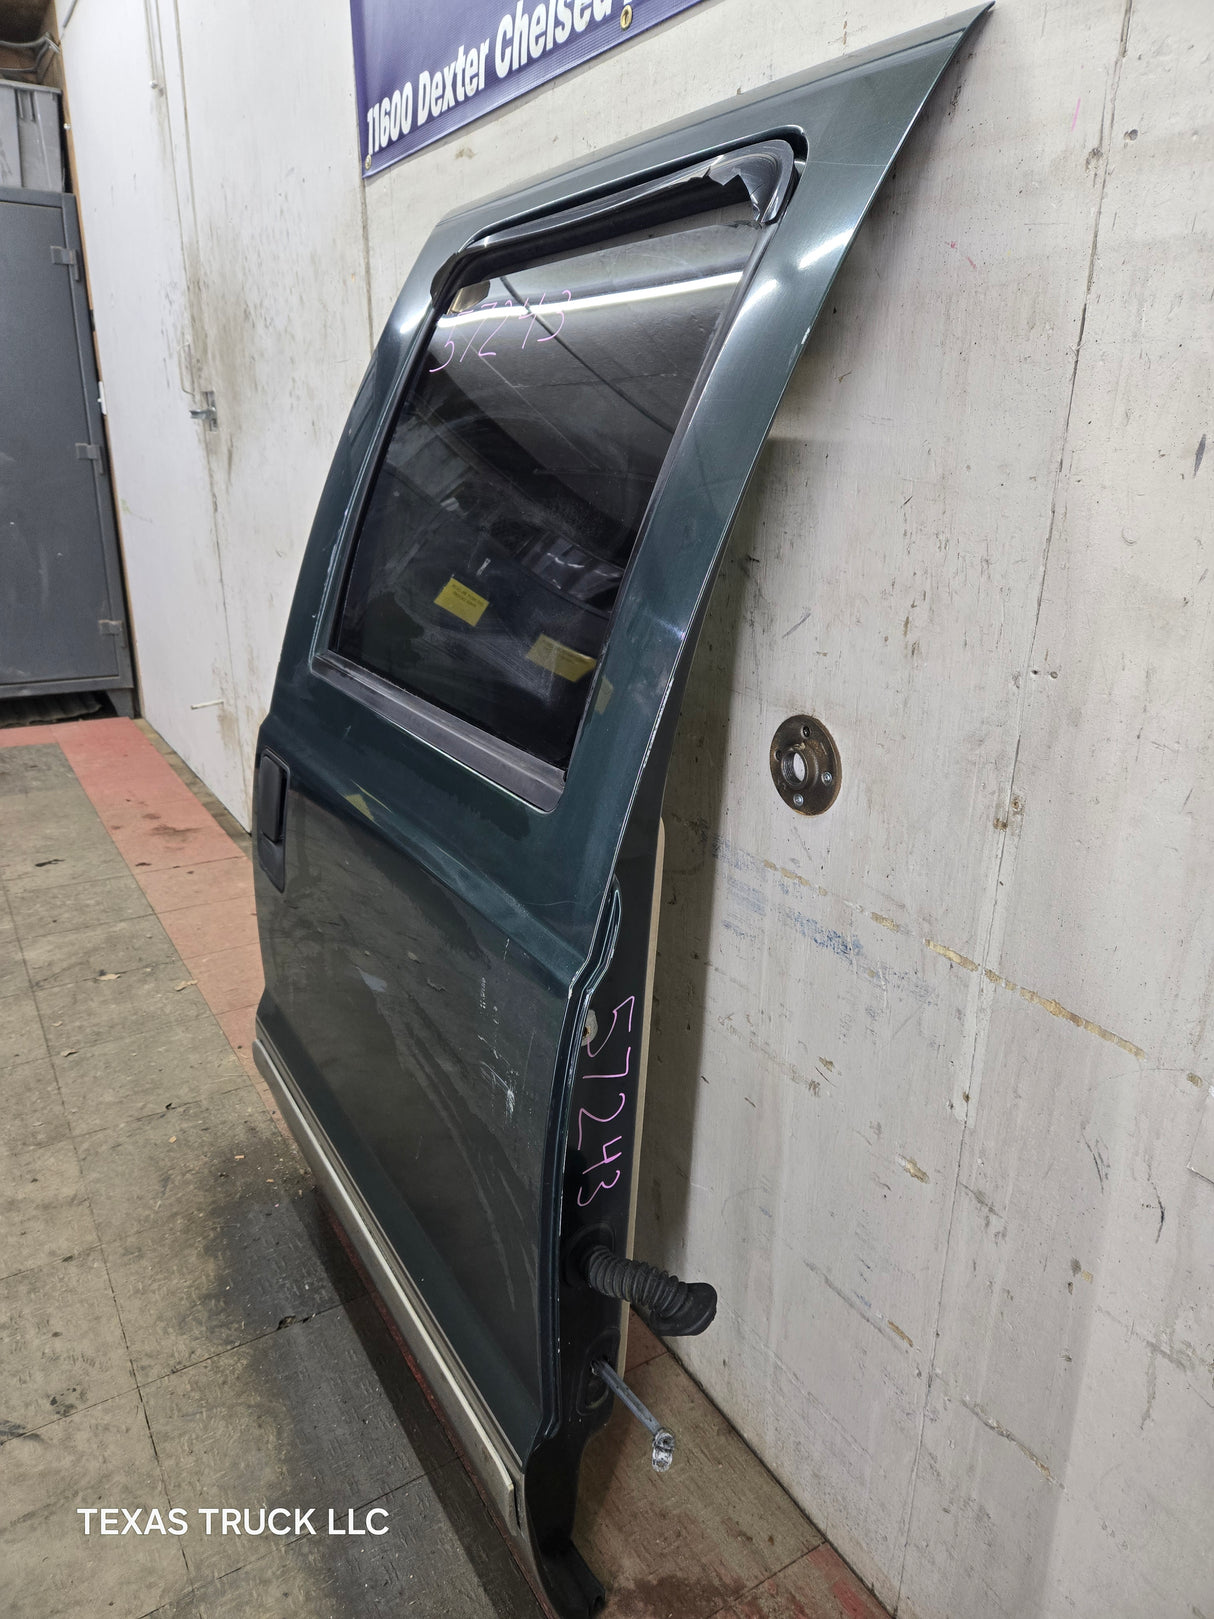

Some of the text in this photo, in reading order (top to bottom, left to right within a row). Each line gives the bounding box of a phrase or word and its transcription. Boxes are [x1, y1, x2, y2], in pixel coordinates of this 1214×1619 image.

[367, 81, 413, 156] 11600
[417, 38, 490, 126] Dexter
[577, 995, 635, 1207] 57243
